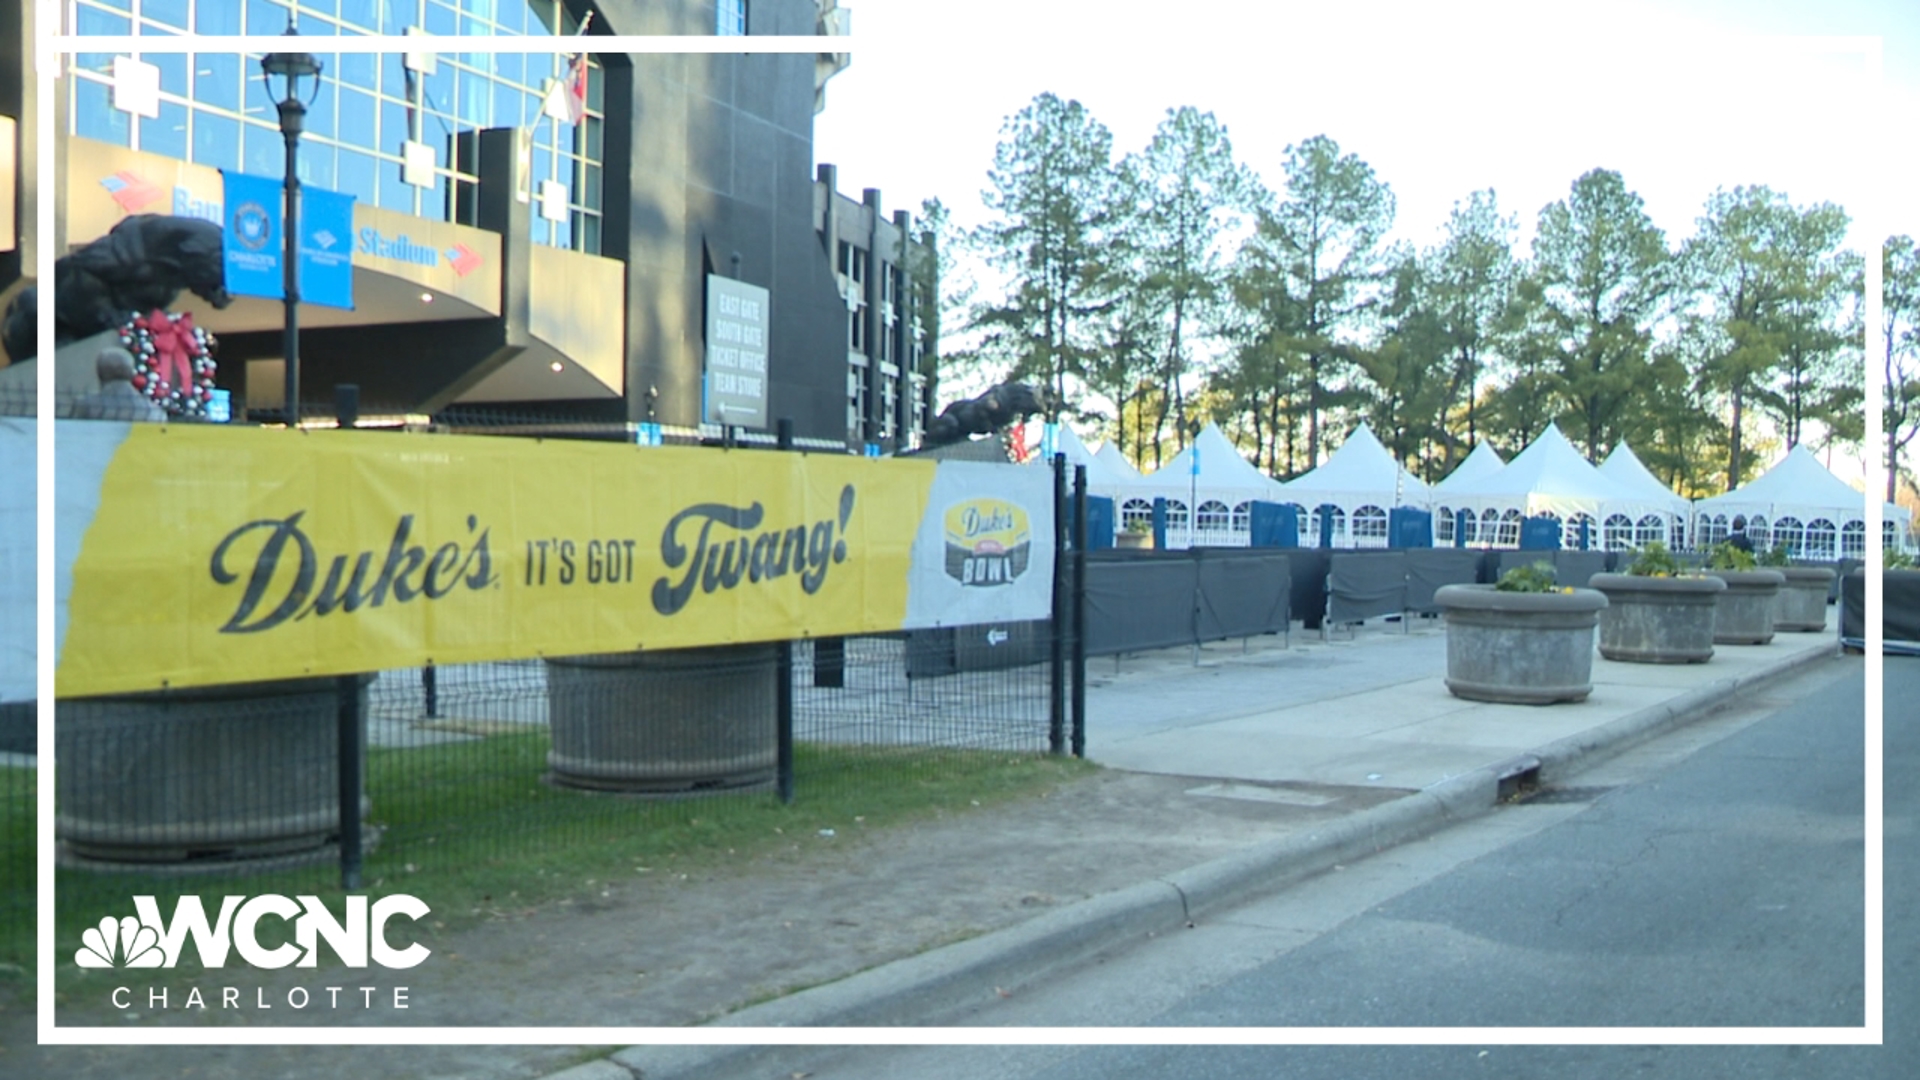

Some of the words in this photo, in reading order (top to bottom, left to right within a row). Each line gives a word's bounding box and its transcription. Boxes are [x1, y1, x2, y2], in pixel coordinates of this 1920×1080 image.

[173, 186, 223, 227] Ban
[360, 226, 438, 267] Stadium
[719, 293, 740, 317] EAST
[740, 298, 760, 322] GATE
[715, 319, 741, 343] SOUTH
[743, 325, 762, 347] GATE
[710, 344, 739, 368] TICKET
[739, 350, 766, 373] OFFICE
[713, 371, 737, 395] TEAM
[737, 375, 762, 398] STORE
[962, 507, 1013, 538] Duke's
[210, 510, 497, 634] Duke's
[526, 538, 576, 586] IT'S
[587, 539, 636, 584] GOT
[651, 483, 855, 616] Twang!
[962, 557, 1014, 584] BOWL
